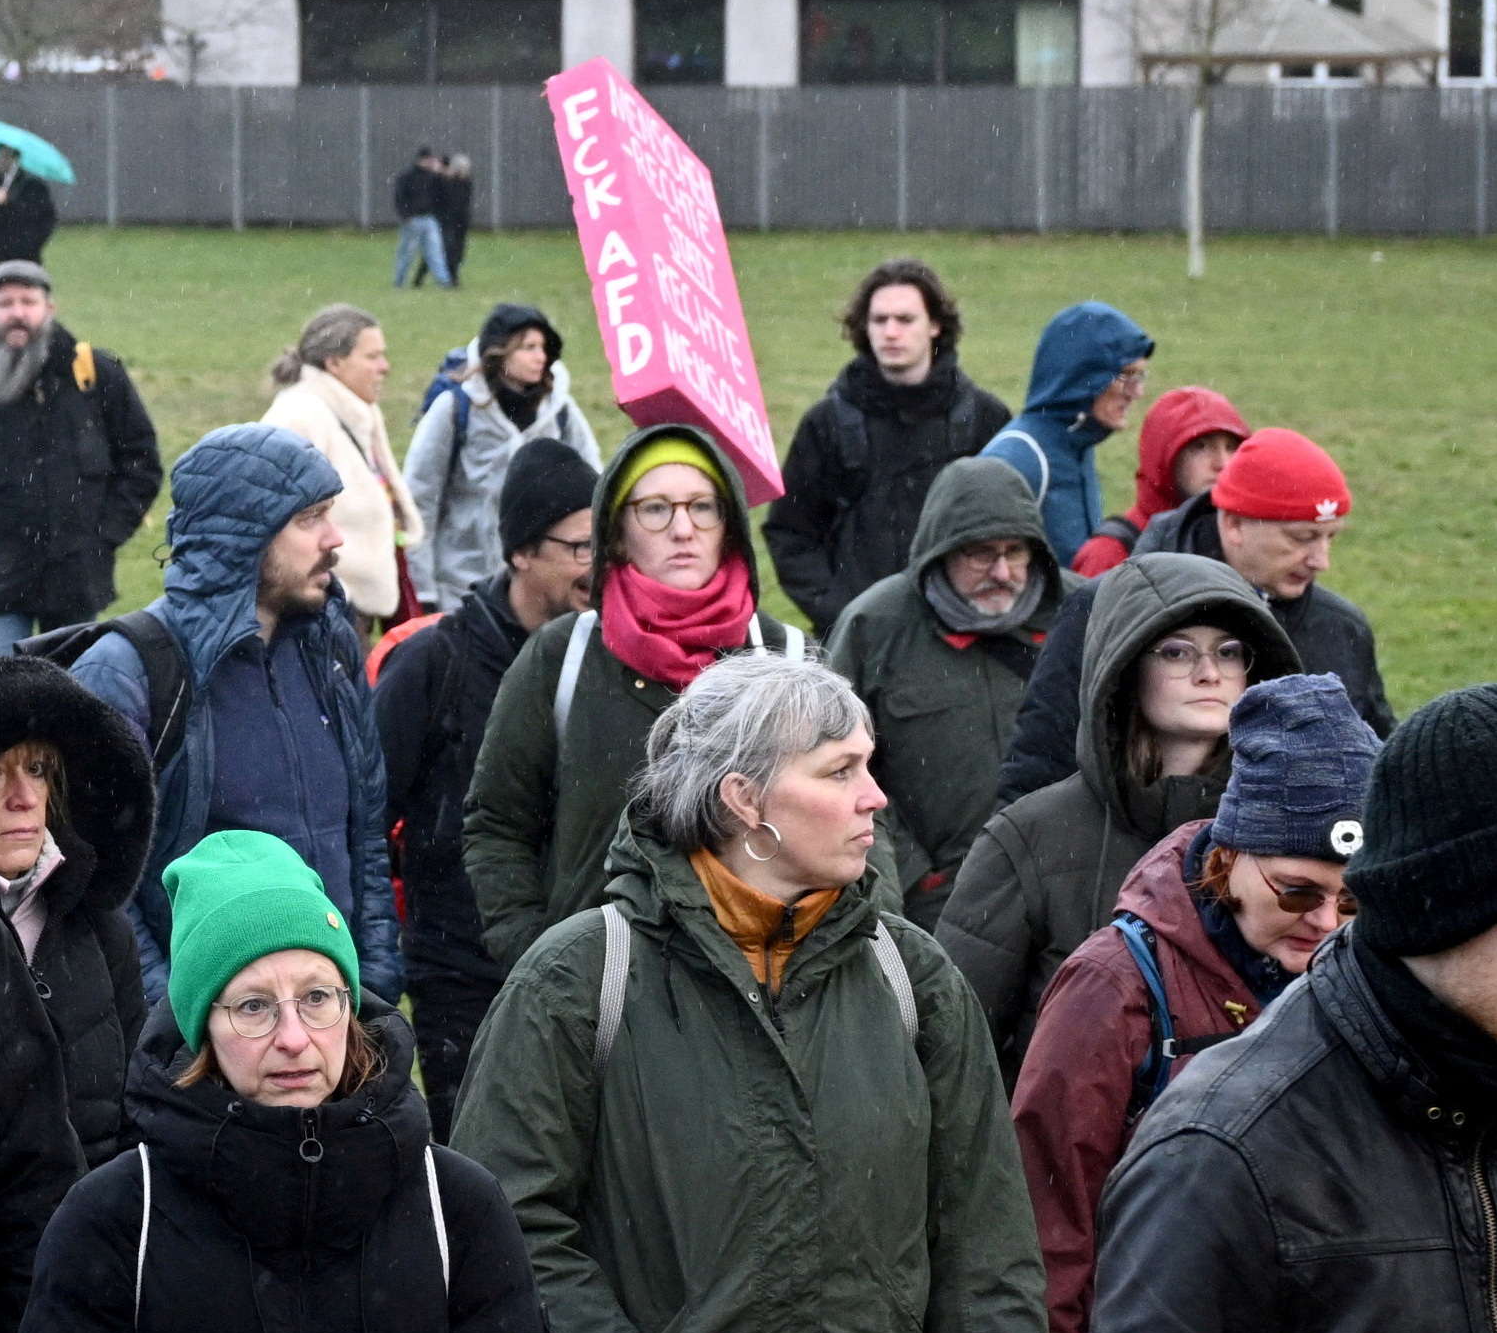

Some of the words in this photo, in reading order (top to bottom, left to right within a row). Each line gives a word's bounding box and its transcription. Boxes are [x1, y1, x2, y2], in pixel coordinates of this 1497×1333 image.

[607, 74, 721, 224] MENSCHEN
[562, 88, 622, 220] FCK
[597, 230, 653, 376] AFD
[652, 252, 746, 386] RECHTE
[662, 320, 780, 473] MENSCHEN
